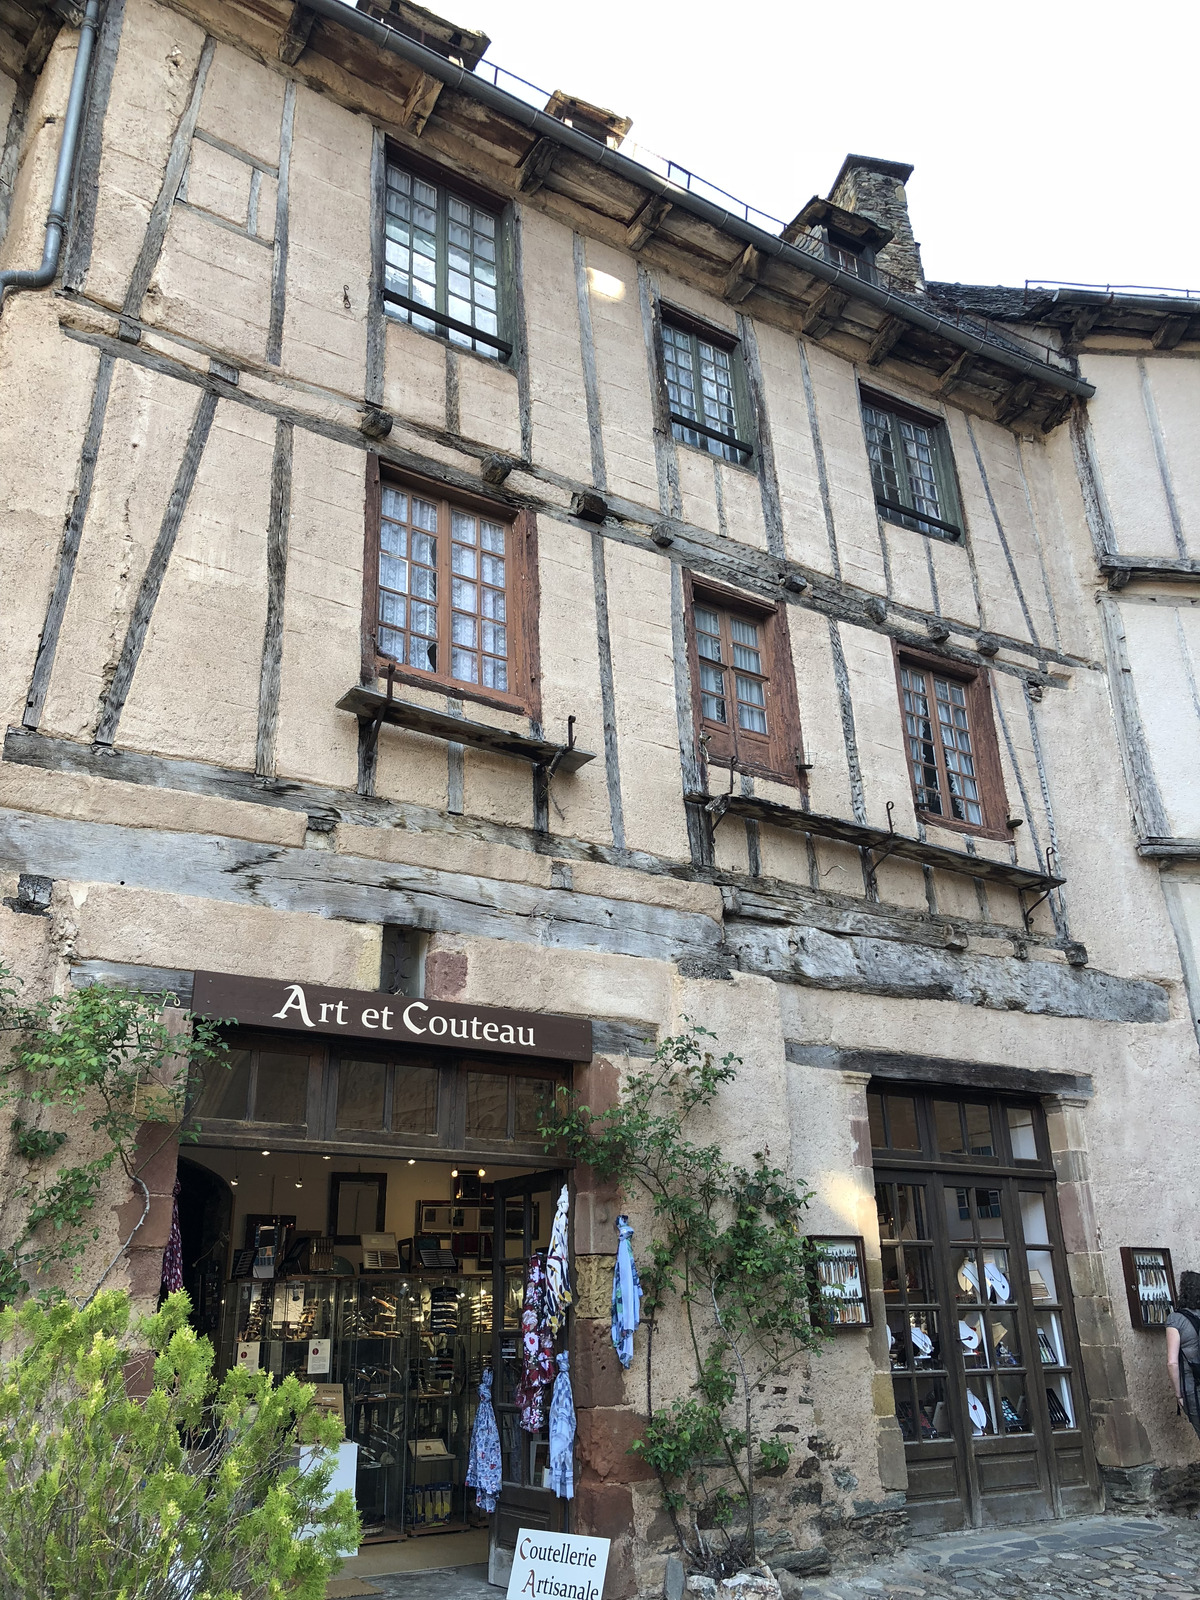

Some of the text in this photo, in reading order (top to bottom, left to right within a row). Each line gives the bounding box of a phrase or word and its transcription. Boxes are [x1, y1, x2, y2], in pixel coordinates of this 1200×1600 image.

[272, 984, 536, 1046] Art et Couteau
[519, 1537, 597, 1568] Coutellerie
[521, 1569, 599, 1600] Artisanale
